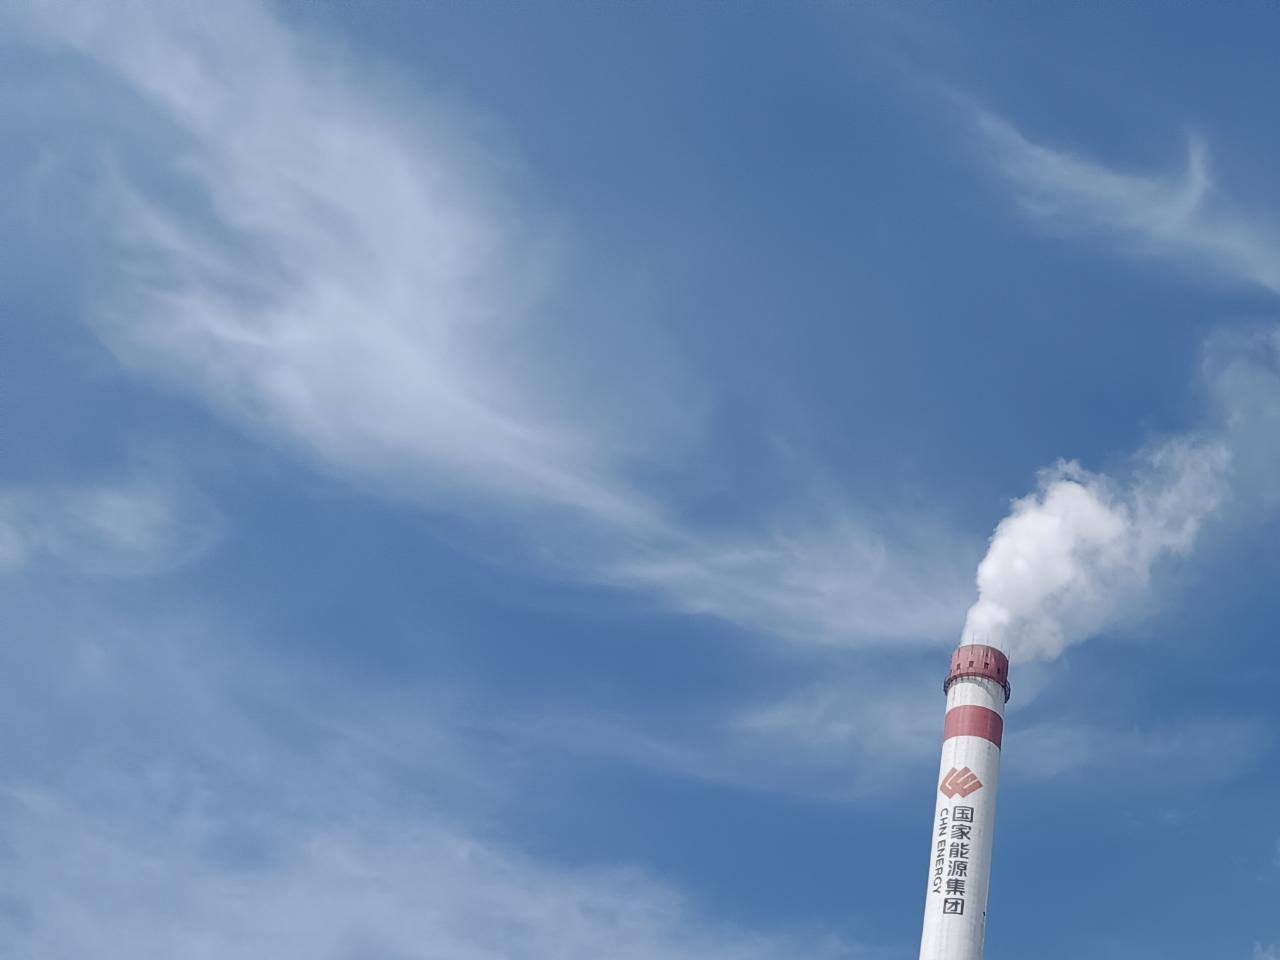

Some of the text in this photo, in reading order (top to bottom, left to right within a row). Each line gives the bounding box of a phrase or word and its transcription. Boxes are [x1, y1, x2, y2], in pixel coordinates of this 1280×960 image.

[933, 808, 948, 893] CHN ENERGY
[943, 806, 974, 914] 国家能源集团
